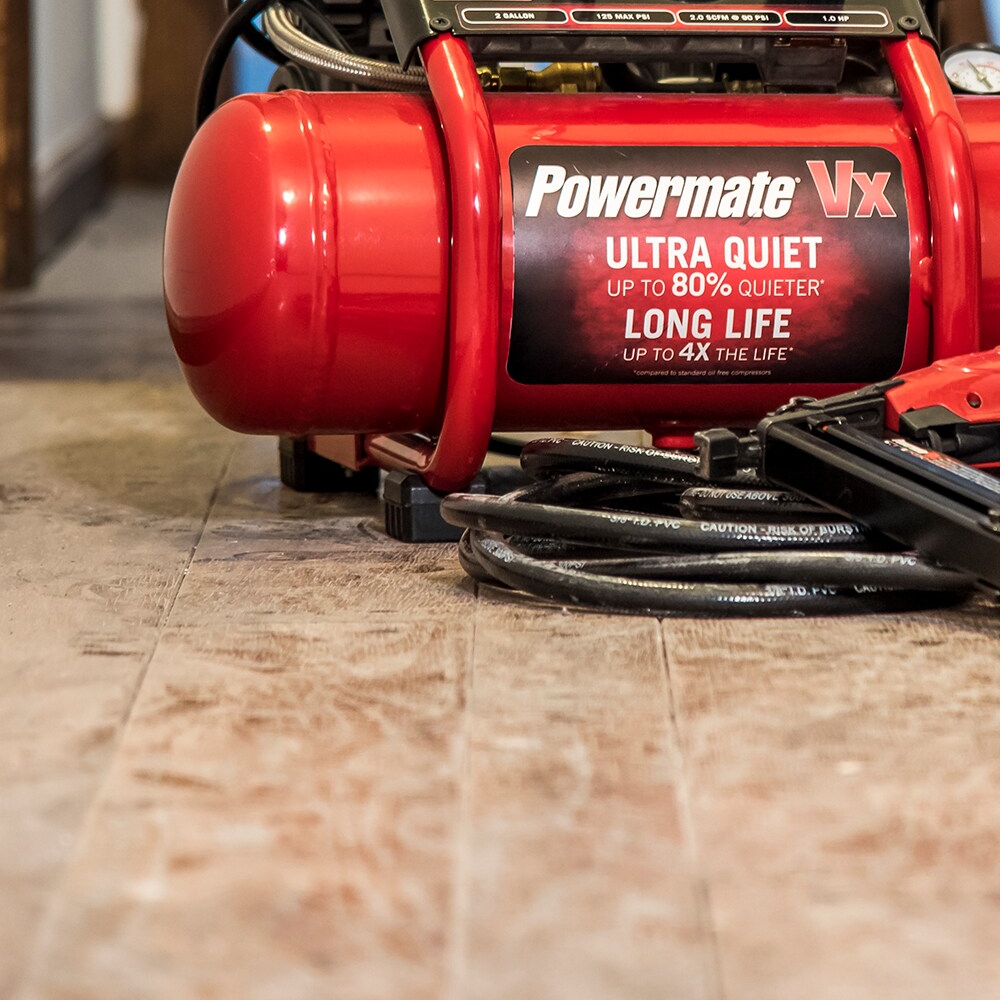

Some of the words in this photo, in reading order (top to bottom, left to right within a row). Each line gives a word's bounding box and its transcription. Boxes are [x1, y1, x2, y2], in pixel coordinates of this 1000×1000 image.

[525, 165, 799, 219] Powermate
[806, 160, 897, 218] Vx
[606, 236, 713, 269] ULTRA
[724, 236, 823, 270] QUIET
[607, 279, 635, 297] UP
[640, 279, 666, 297] TO
[671, 271, 733, 297] 80%
[624, 308, 713, 339] LONG
[725, 308, 792, 339] LIFE
[623, 347, 648, 361] UP
[652, 347, 675, 361] TO
[678, 342, 711, 361] 4X
[716, 347, 749, 361] THE
[572, 439, 612, 450] CAUTION
[618, 445, 645, 455] RISK
[725, 491, 745, 500] USE
[743, 491, 779, 501] ABOVE
[654, 519, 681, 529] PVC
[700, 523, 757, 534] CAUTION
[767, 524, 796, 536] RISK
[891, 555, 917, 566] PVC
